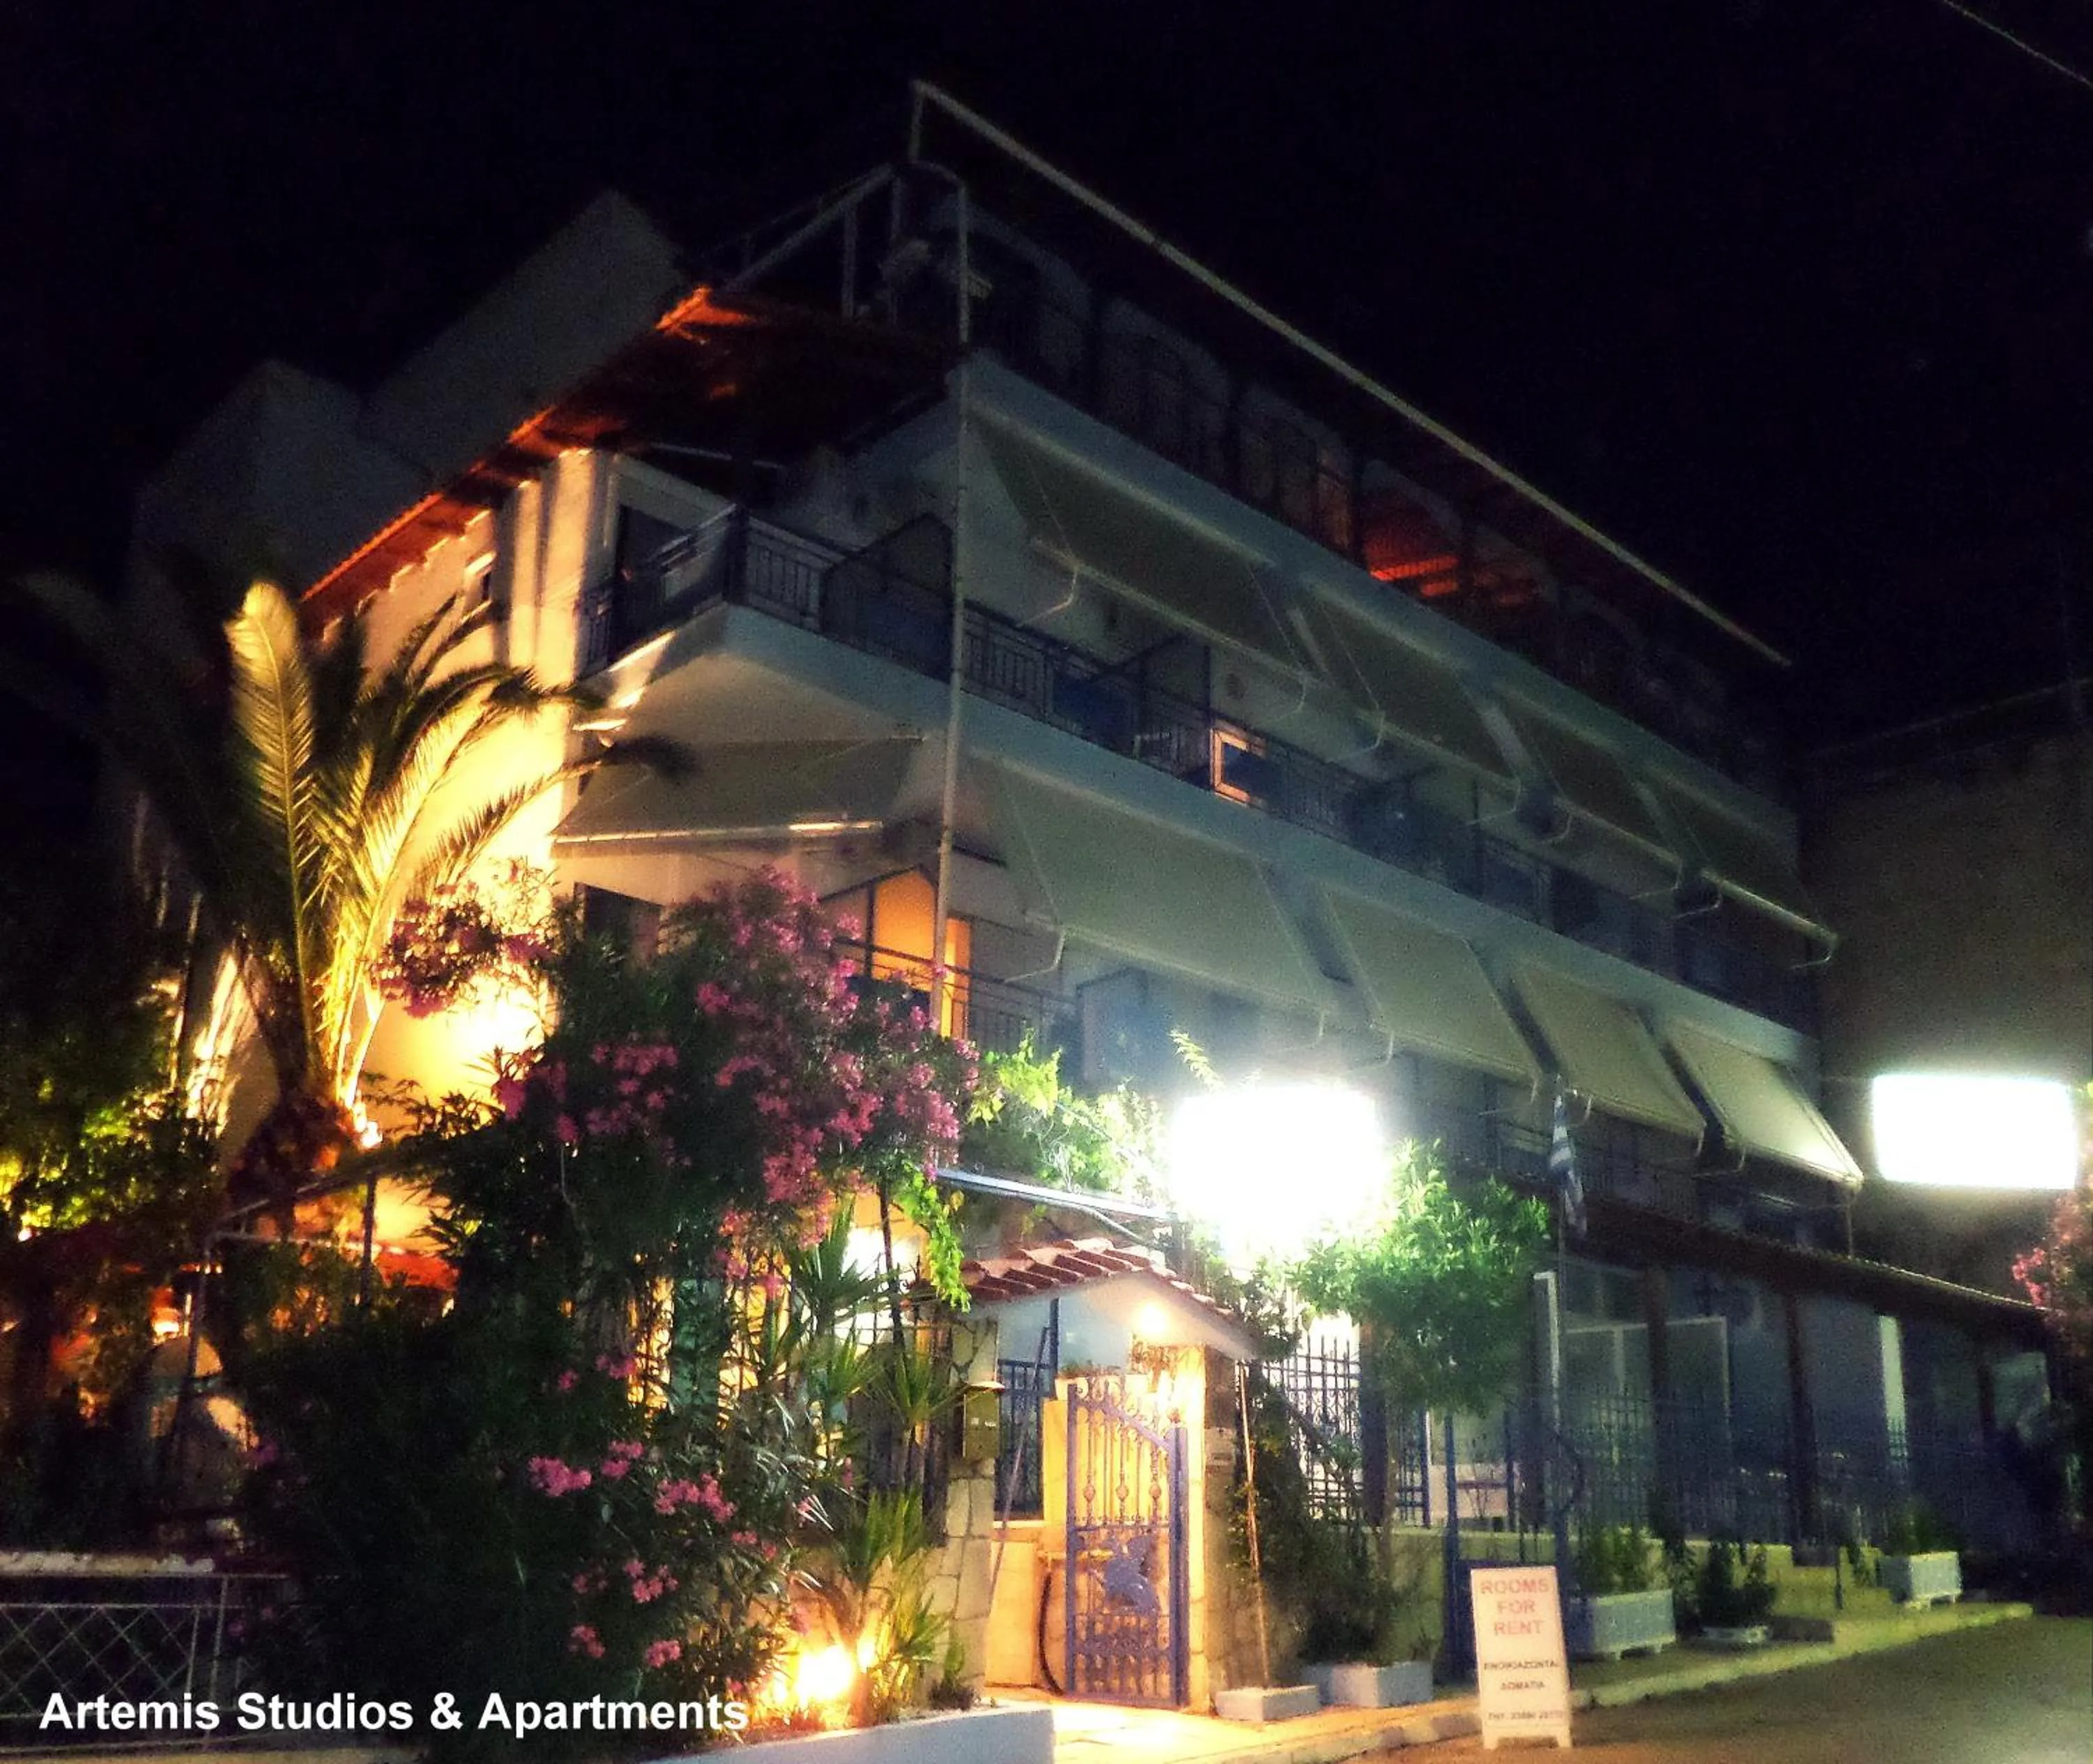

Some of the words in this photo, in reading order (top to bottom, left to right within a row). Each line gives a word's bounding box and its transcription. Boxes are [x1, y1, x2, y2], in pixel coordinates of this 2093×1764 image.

[1480, 1578, 1550, 1594] ROOMS
[1496, 1599, 1536, 1614] FOR
[1494, 1619, 1545, 1636] RENT
